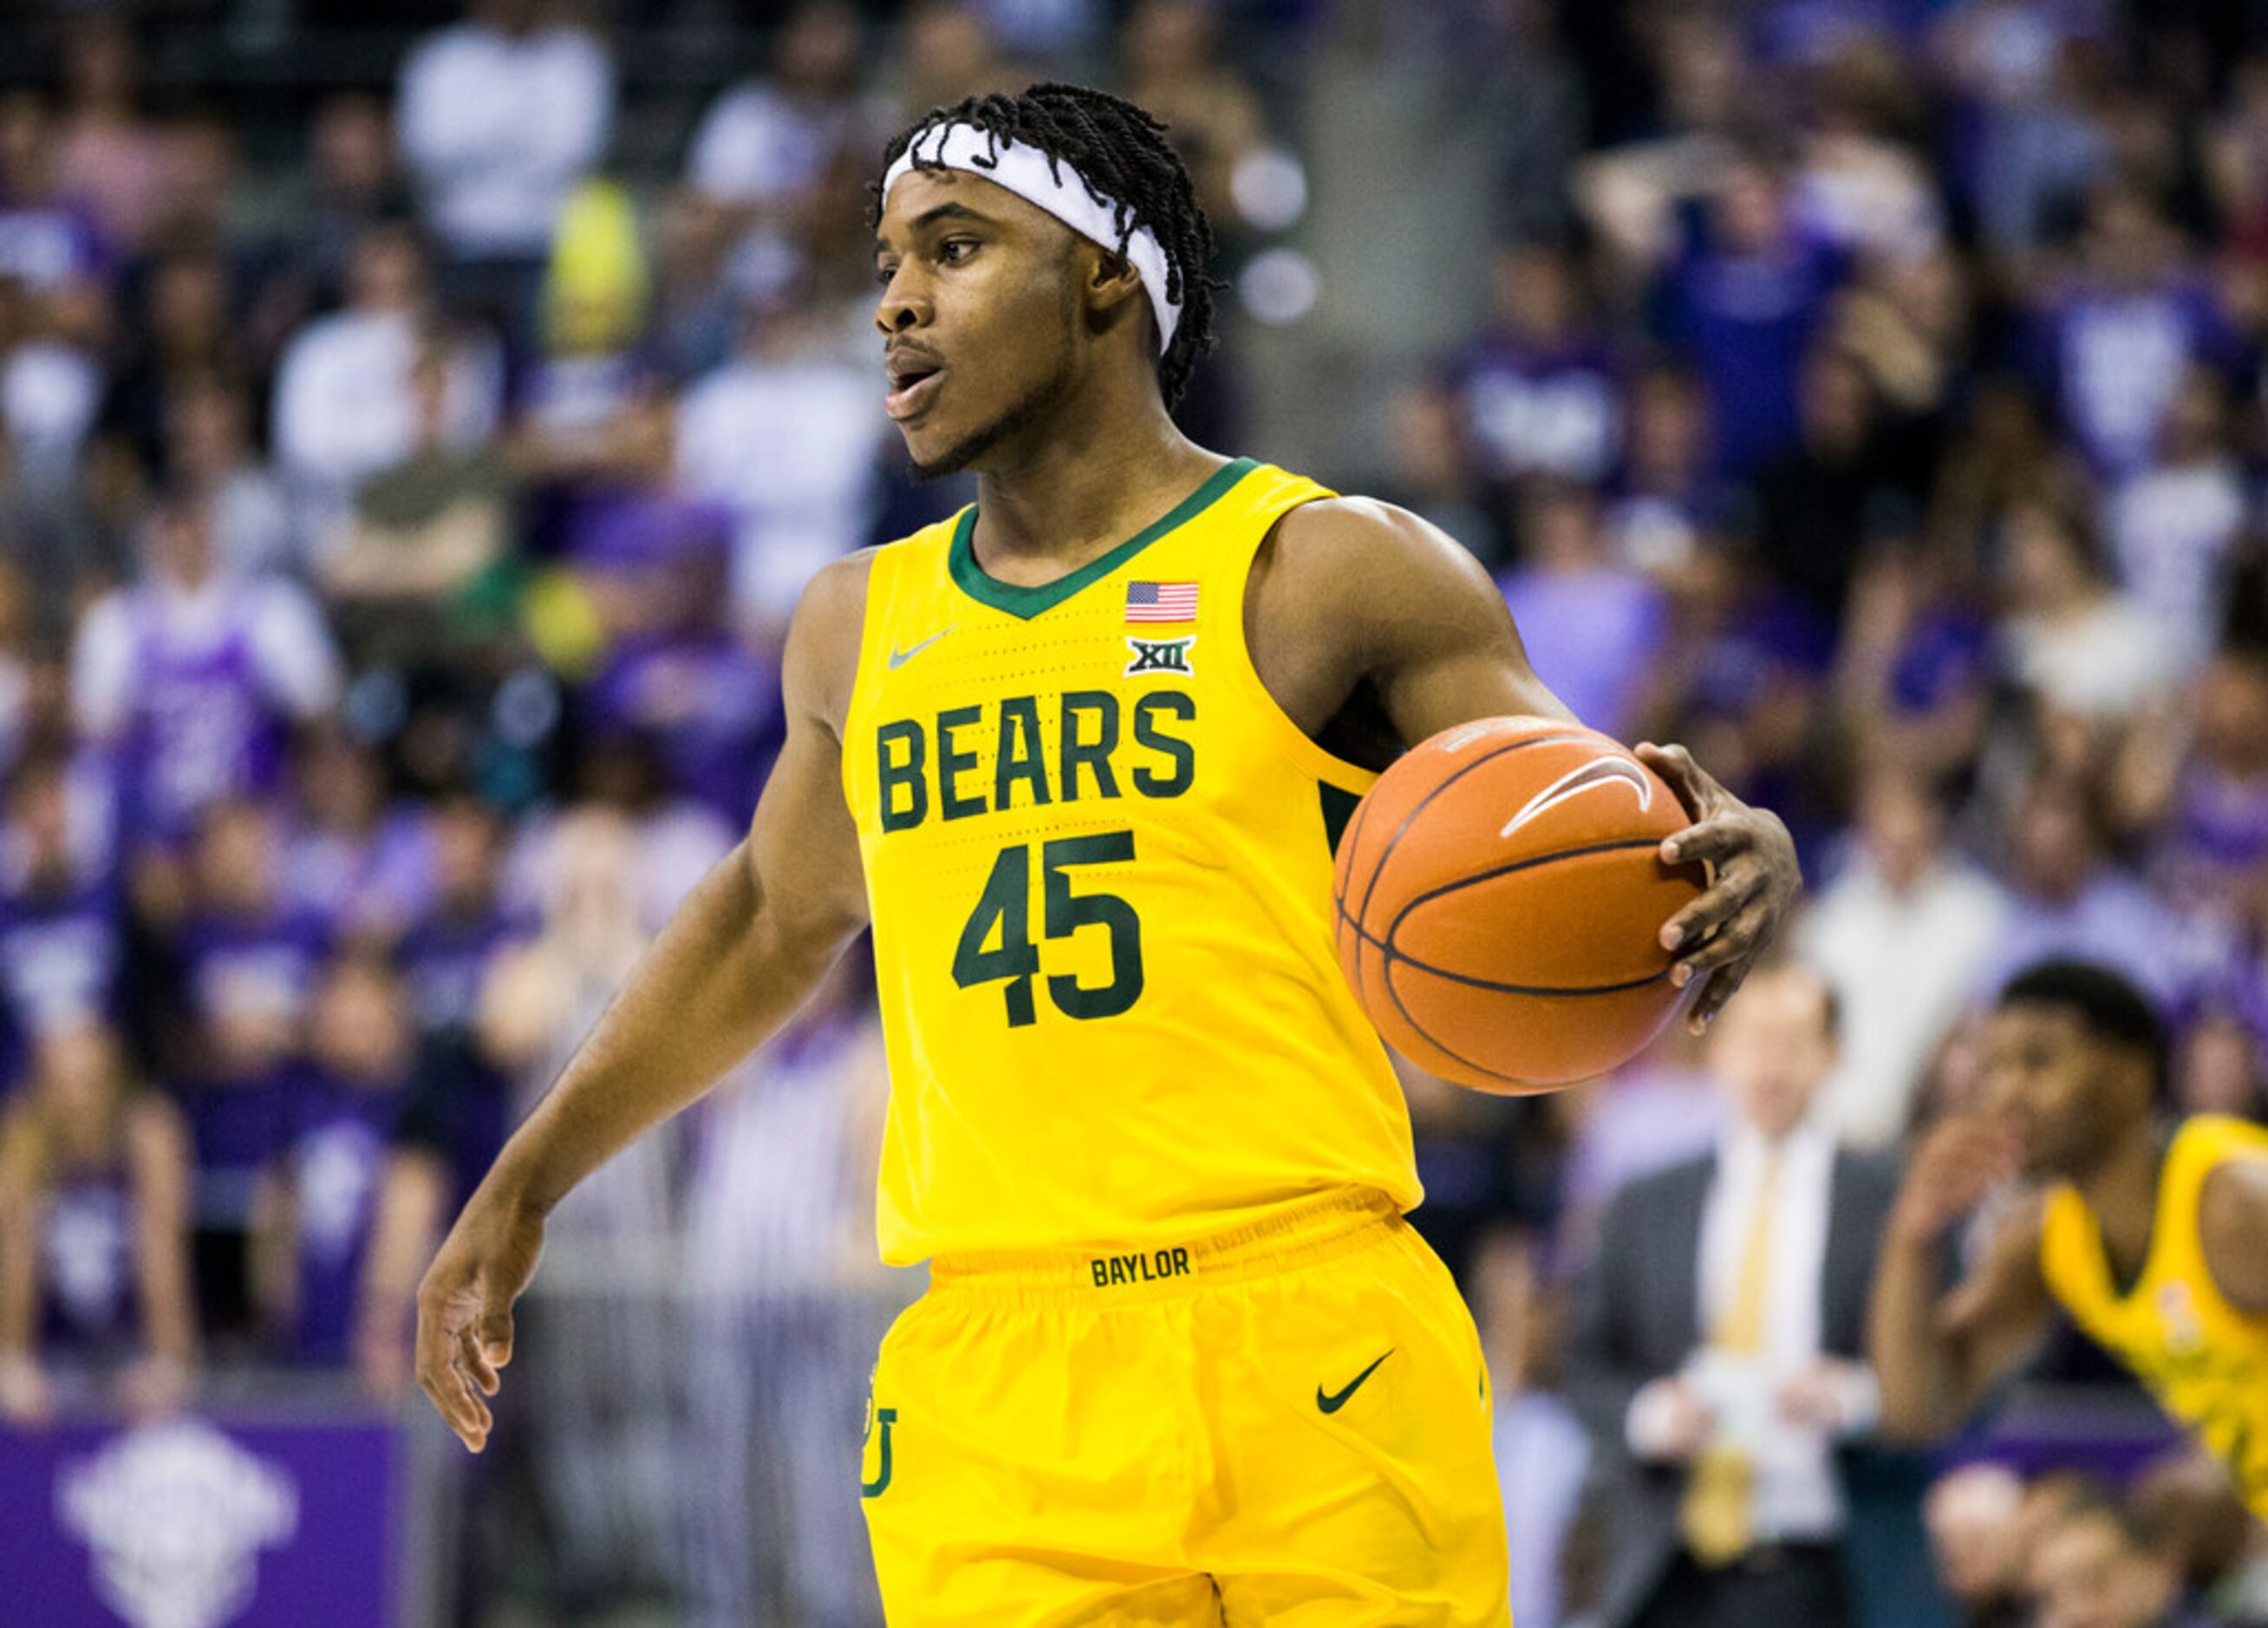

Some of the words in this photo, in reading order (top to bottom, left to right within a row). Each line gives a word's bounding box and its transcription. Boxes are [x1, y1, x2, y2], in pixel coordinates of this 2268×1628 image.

[1129, 640, 1191, 673] XII
[877, 690, 1196, 835] BEARS
[951, 830, 1145, 1029] 45
[1091, 1247, 1191, 1287] BAYLOR
